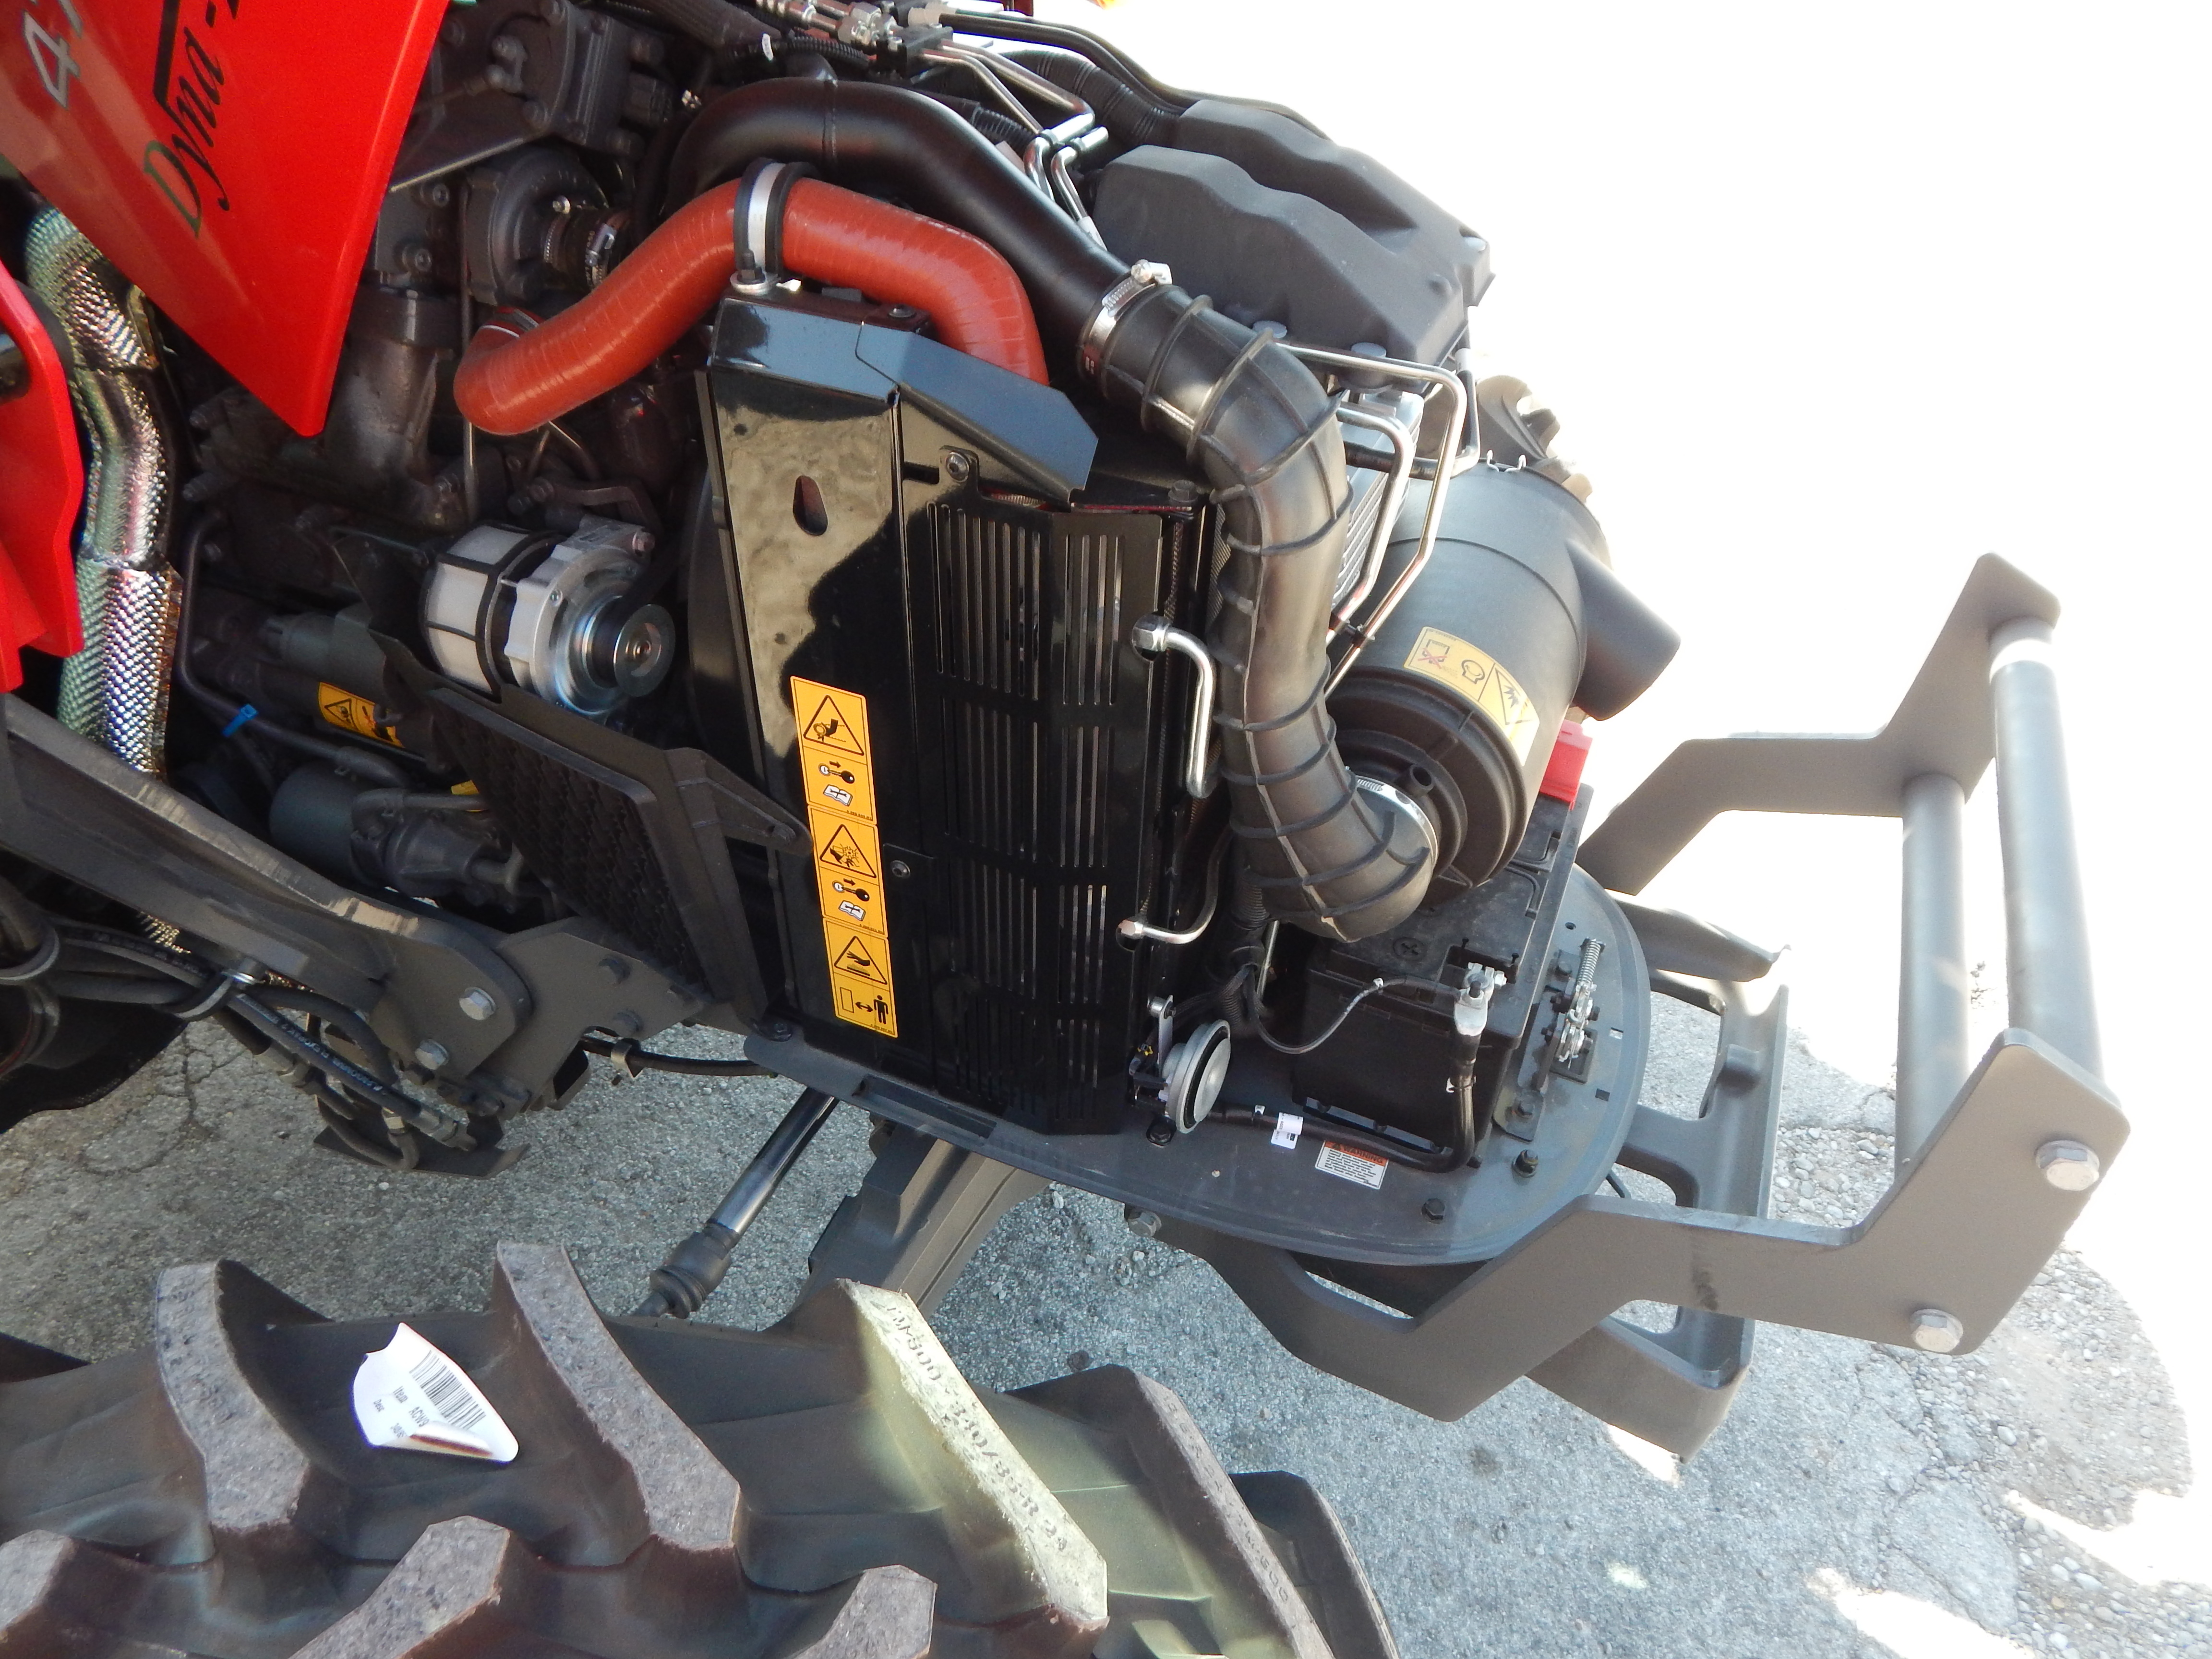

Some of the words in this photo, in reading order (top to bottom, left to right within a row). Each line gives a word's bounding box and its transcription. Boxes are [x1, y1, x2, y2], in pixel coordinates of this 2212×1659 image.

[144, 0, 240, 238] Dyna-
[1344, 1145, 1383, 1164] WARNING
[393, 1385, 409, 1404] Item
